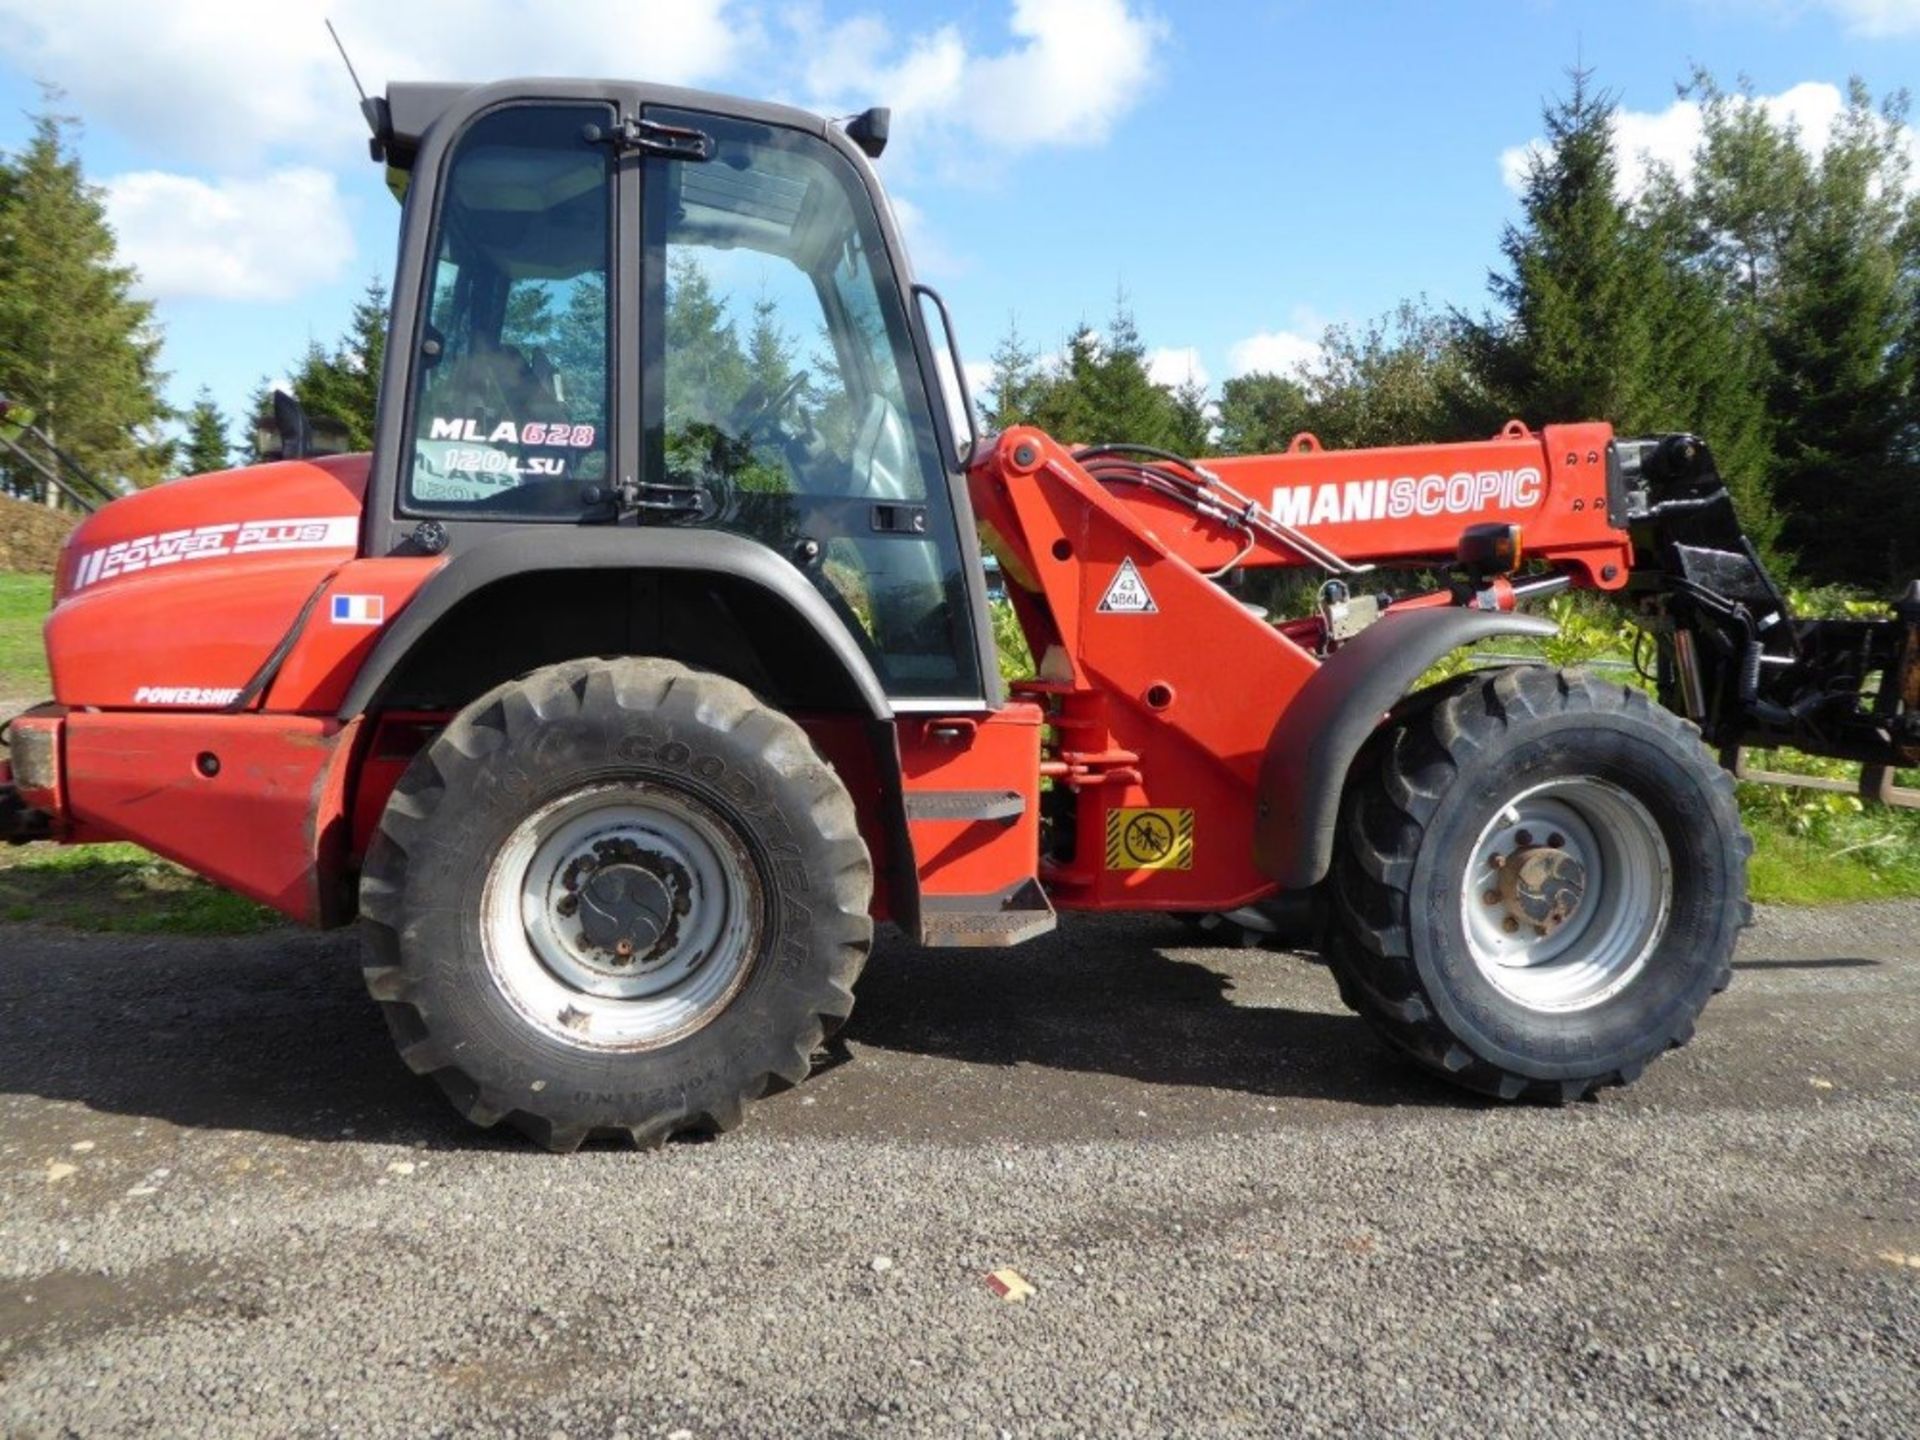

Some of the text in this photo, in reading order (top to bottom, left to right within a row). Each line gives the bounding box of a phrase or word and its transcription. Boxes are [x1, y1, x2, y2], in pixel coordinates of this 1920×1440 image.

[430, 418, 595, 447] MLA628
[1270, 467, 1541, 526] MANISCOPIC
[105, 524, 329, 570] POWER PLUS
[134, 687, 241, 704] POWERSHIF
